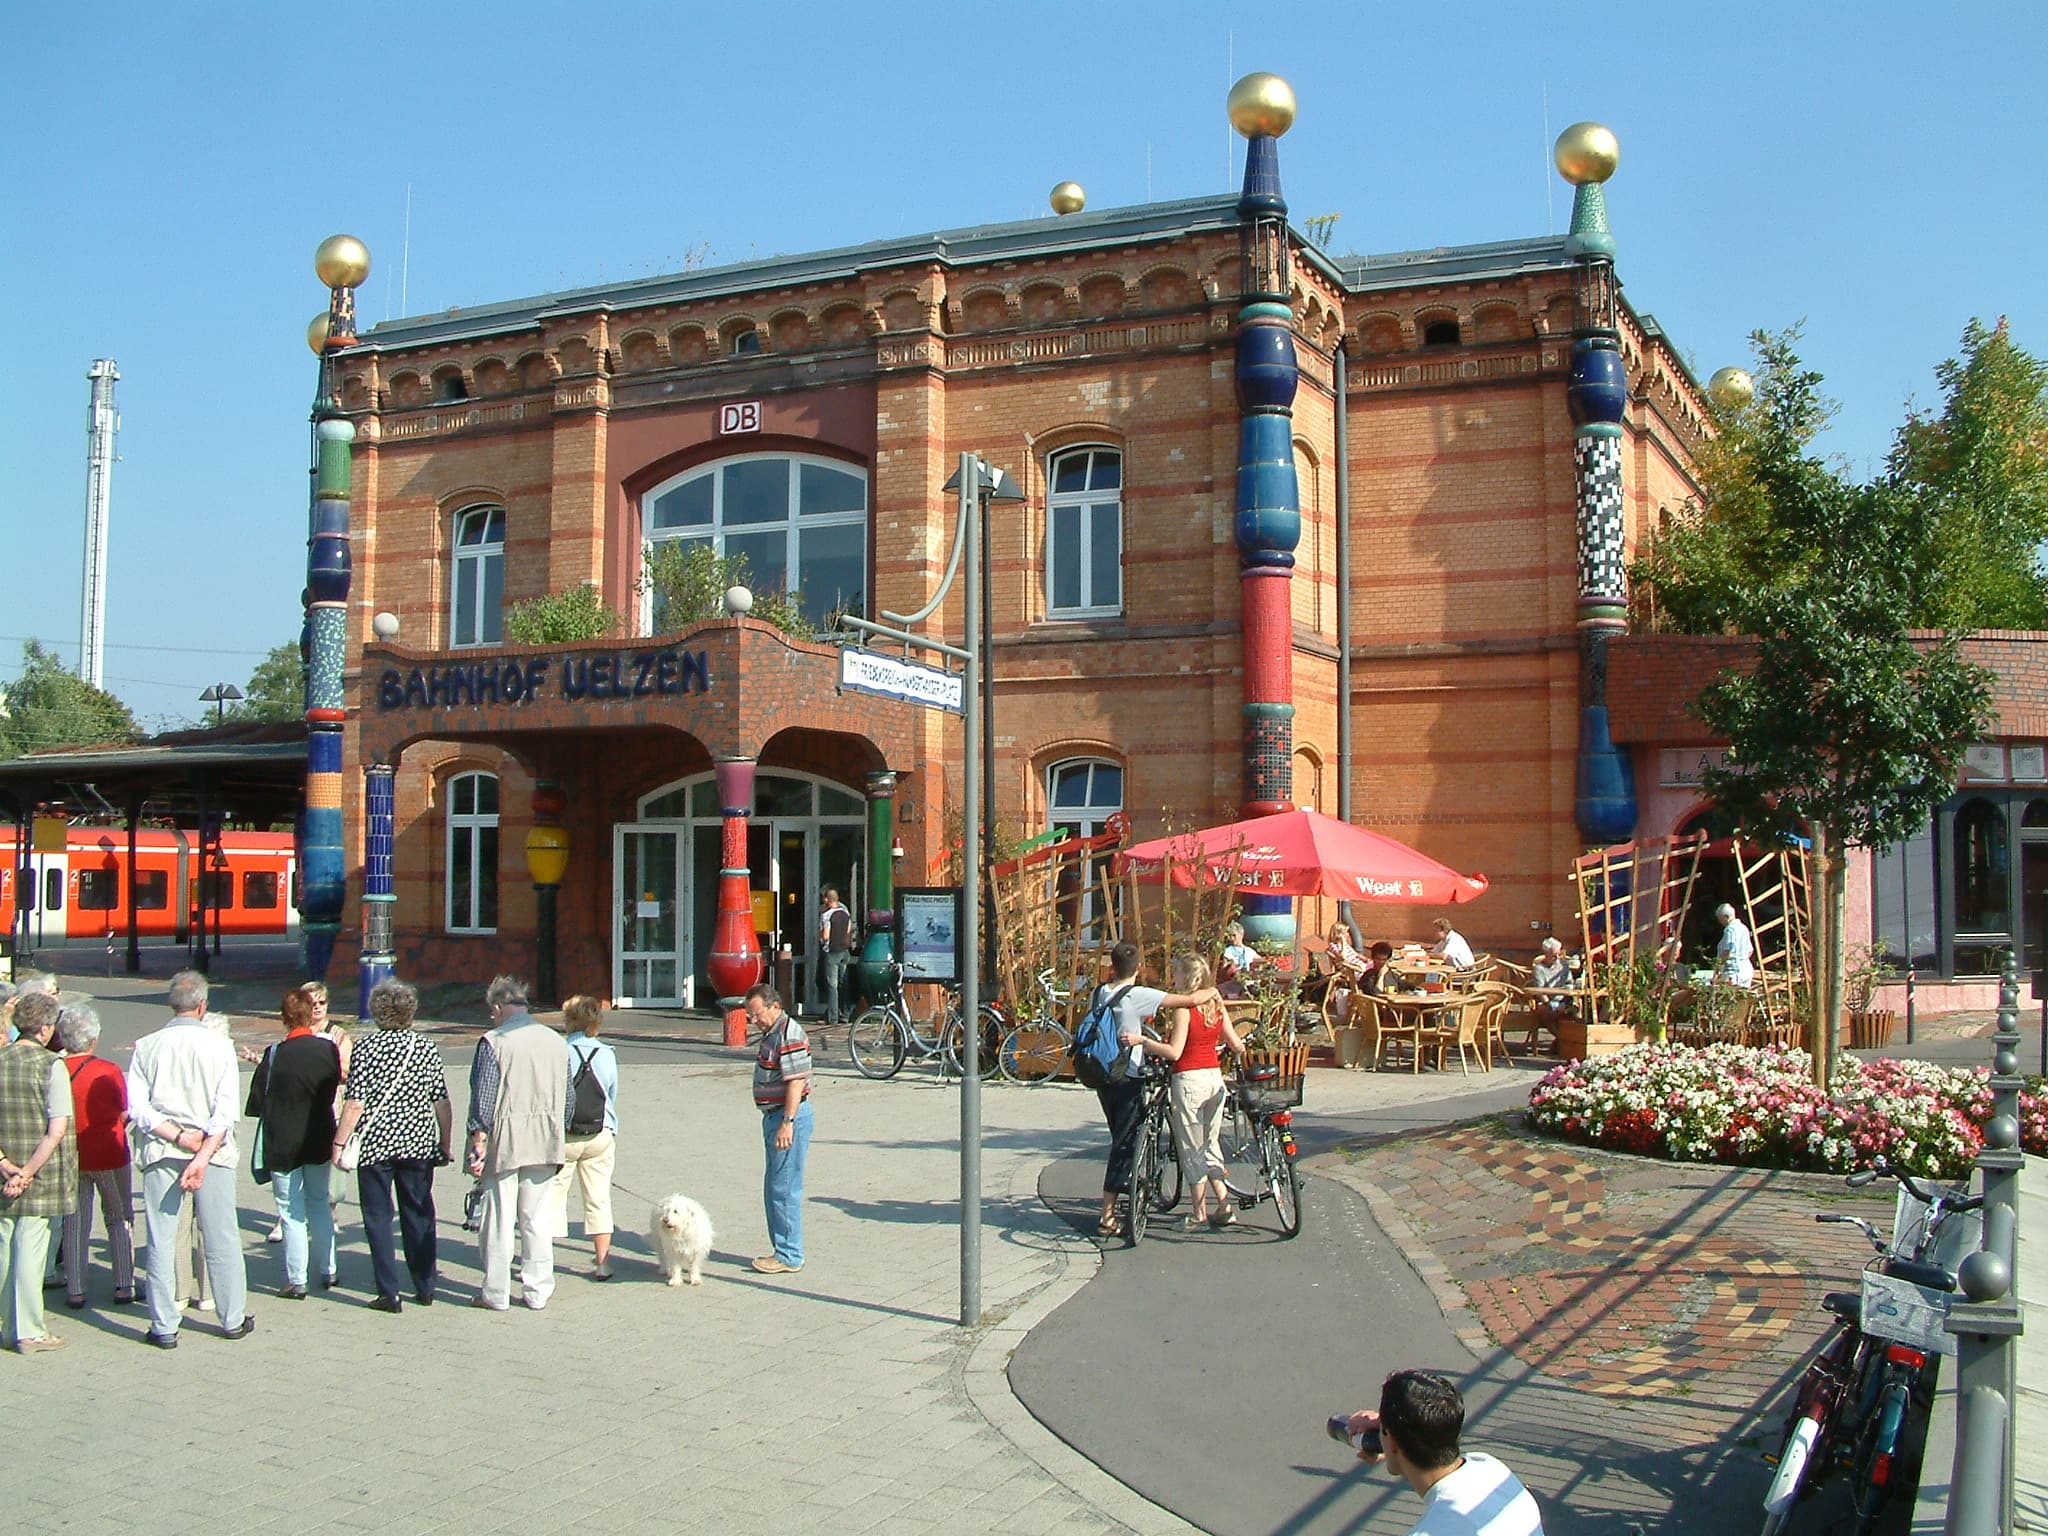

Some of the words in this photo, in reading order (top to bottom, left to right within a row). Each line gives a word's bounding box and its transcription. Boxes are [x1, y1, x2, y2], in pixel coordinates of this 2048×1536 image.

[724, 405, 757, 431] DB
[379, 658, 549, 709] BAHNHOF
[564, 651, 710, 700] UELZEN
[70, 869, 78, 881] 2
[279, 872, 286, 883] 2
[1213, 866, 1261, 886] Wst
[1355, 876, 1403, 896] West
